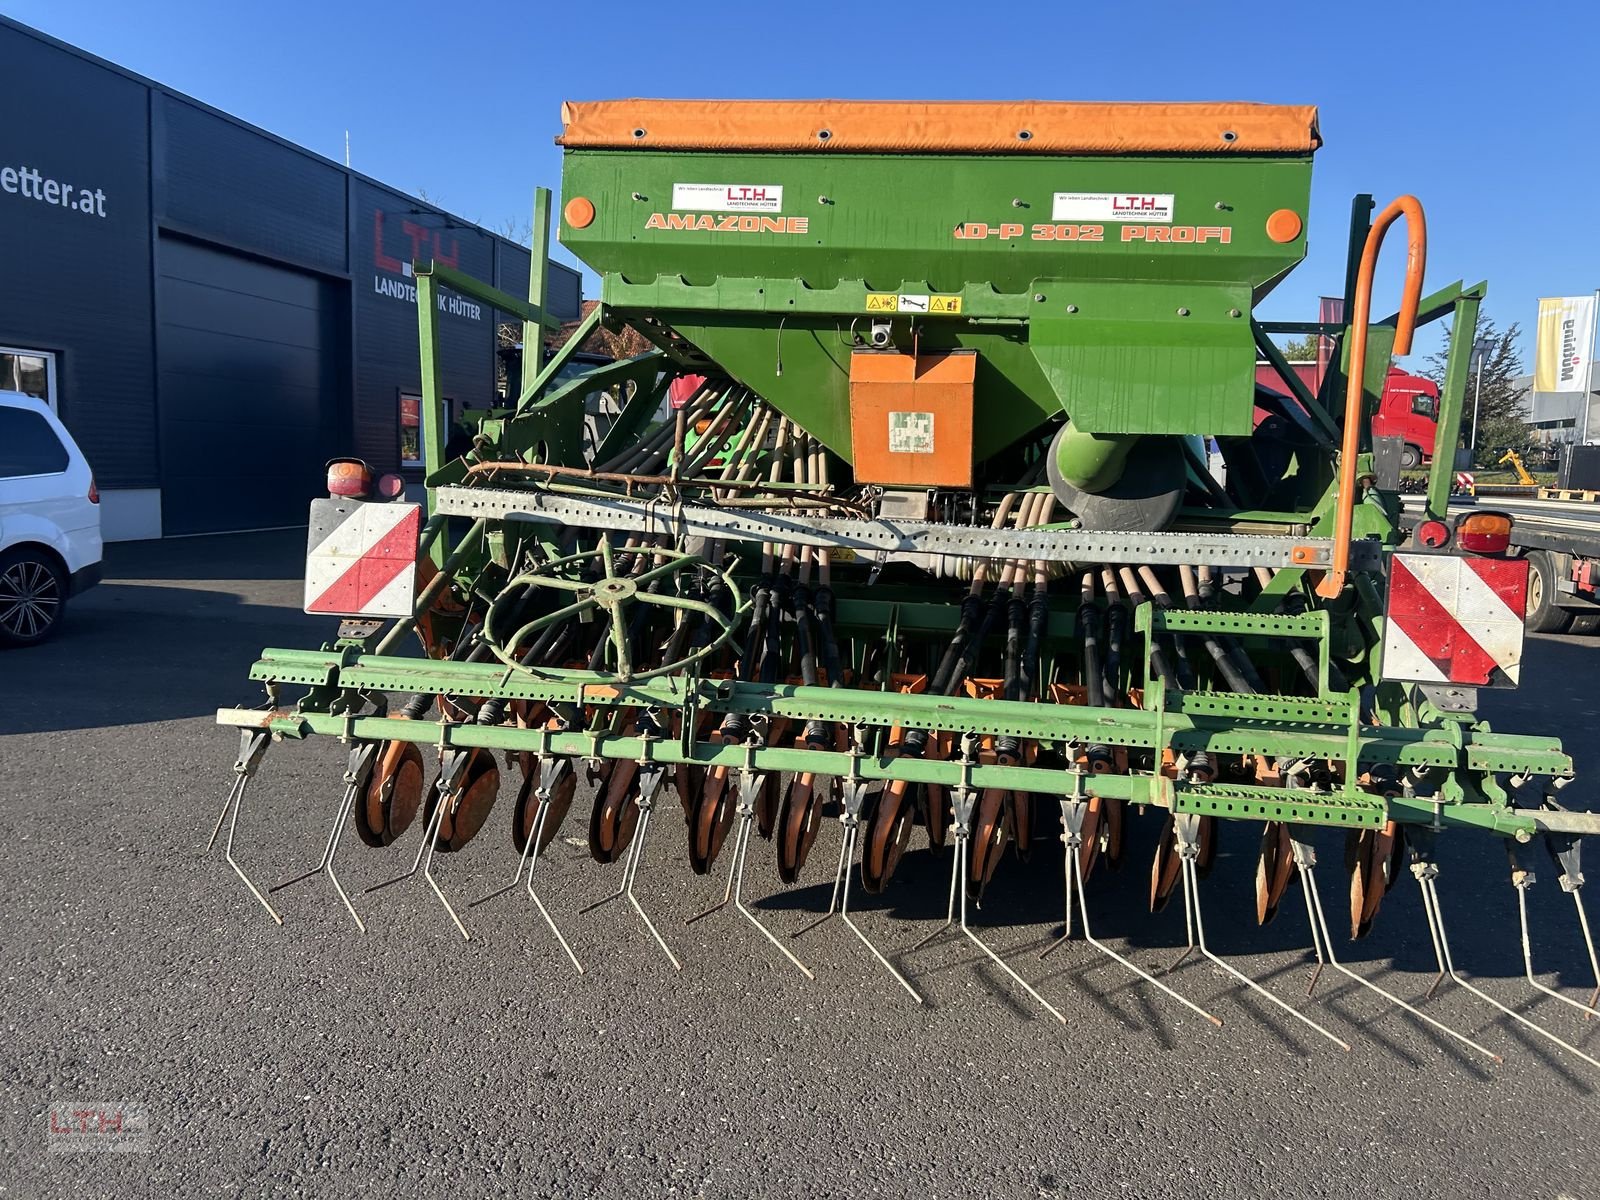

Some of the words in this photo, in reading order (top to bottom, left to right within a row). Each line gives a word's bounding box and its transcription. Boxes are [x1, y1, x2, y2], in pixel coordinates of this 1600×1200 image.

[0, 166, 106, 218] etter.at
[645, 213, 808, 233] AMAZONE
[1031, 224, 1104, 241] 302
[1121, 225, 1232, 243] PROFI
[449, 295, 481, 320] HÜTTER
